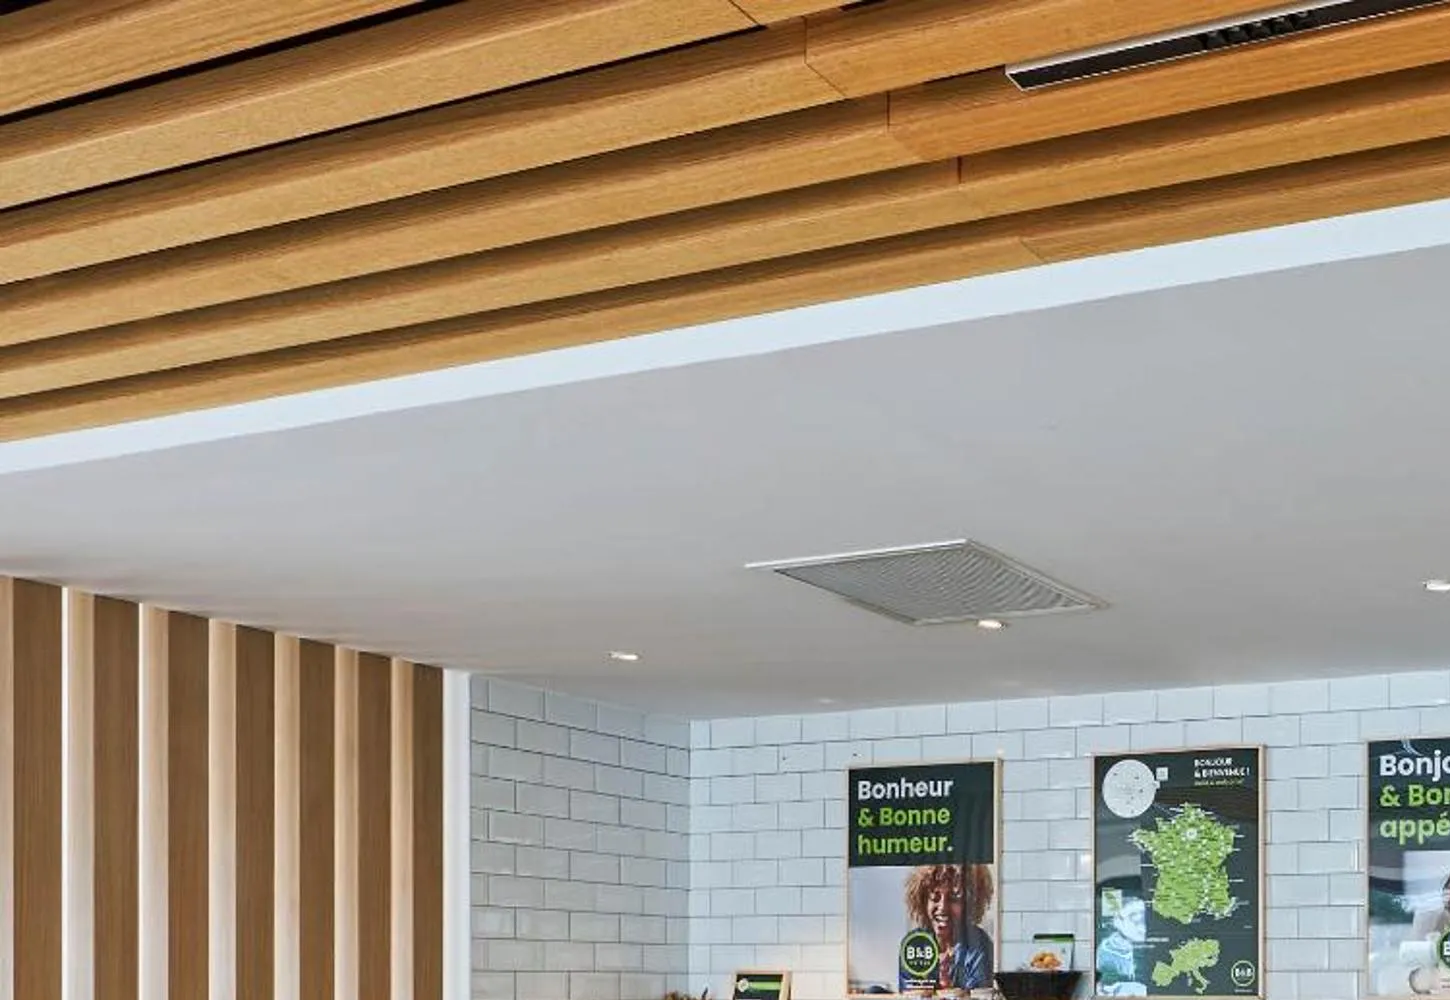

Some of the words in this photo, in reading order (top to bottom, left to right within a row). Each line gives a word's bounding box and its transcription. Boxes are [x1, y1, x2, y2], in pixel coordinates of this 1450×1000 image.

[857, 777, 954, 800] Bonheur
[1379, 784, 1401, 807] &
[857, 807, 874, 827] &
[880, 807, 951, 826] Bonne
[857, 834, 954, 855] humeur.
[906, 946, 934, 960] B&B
